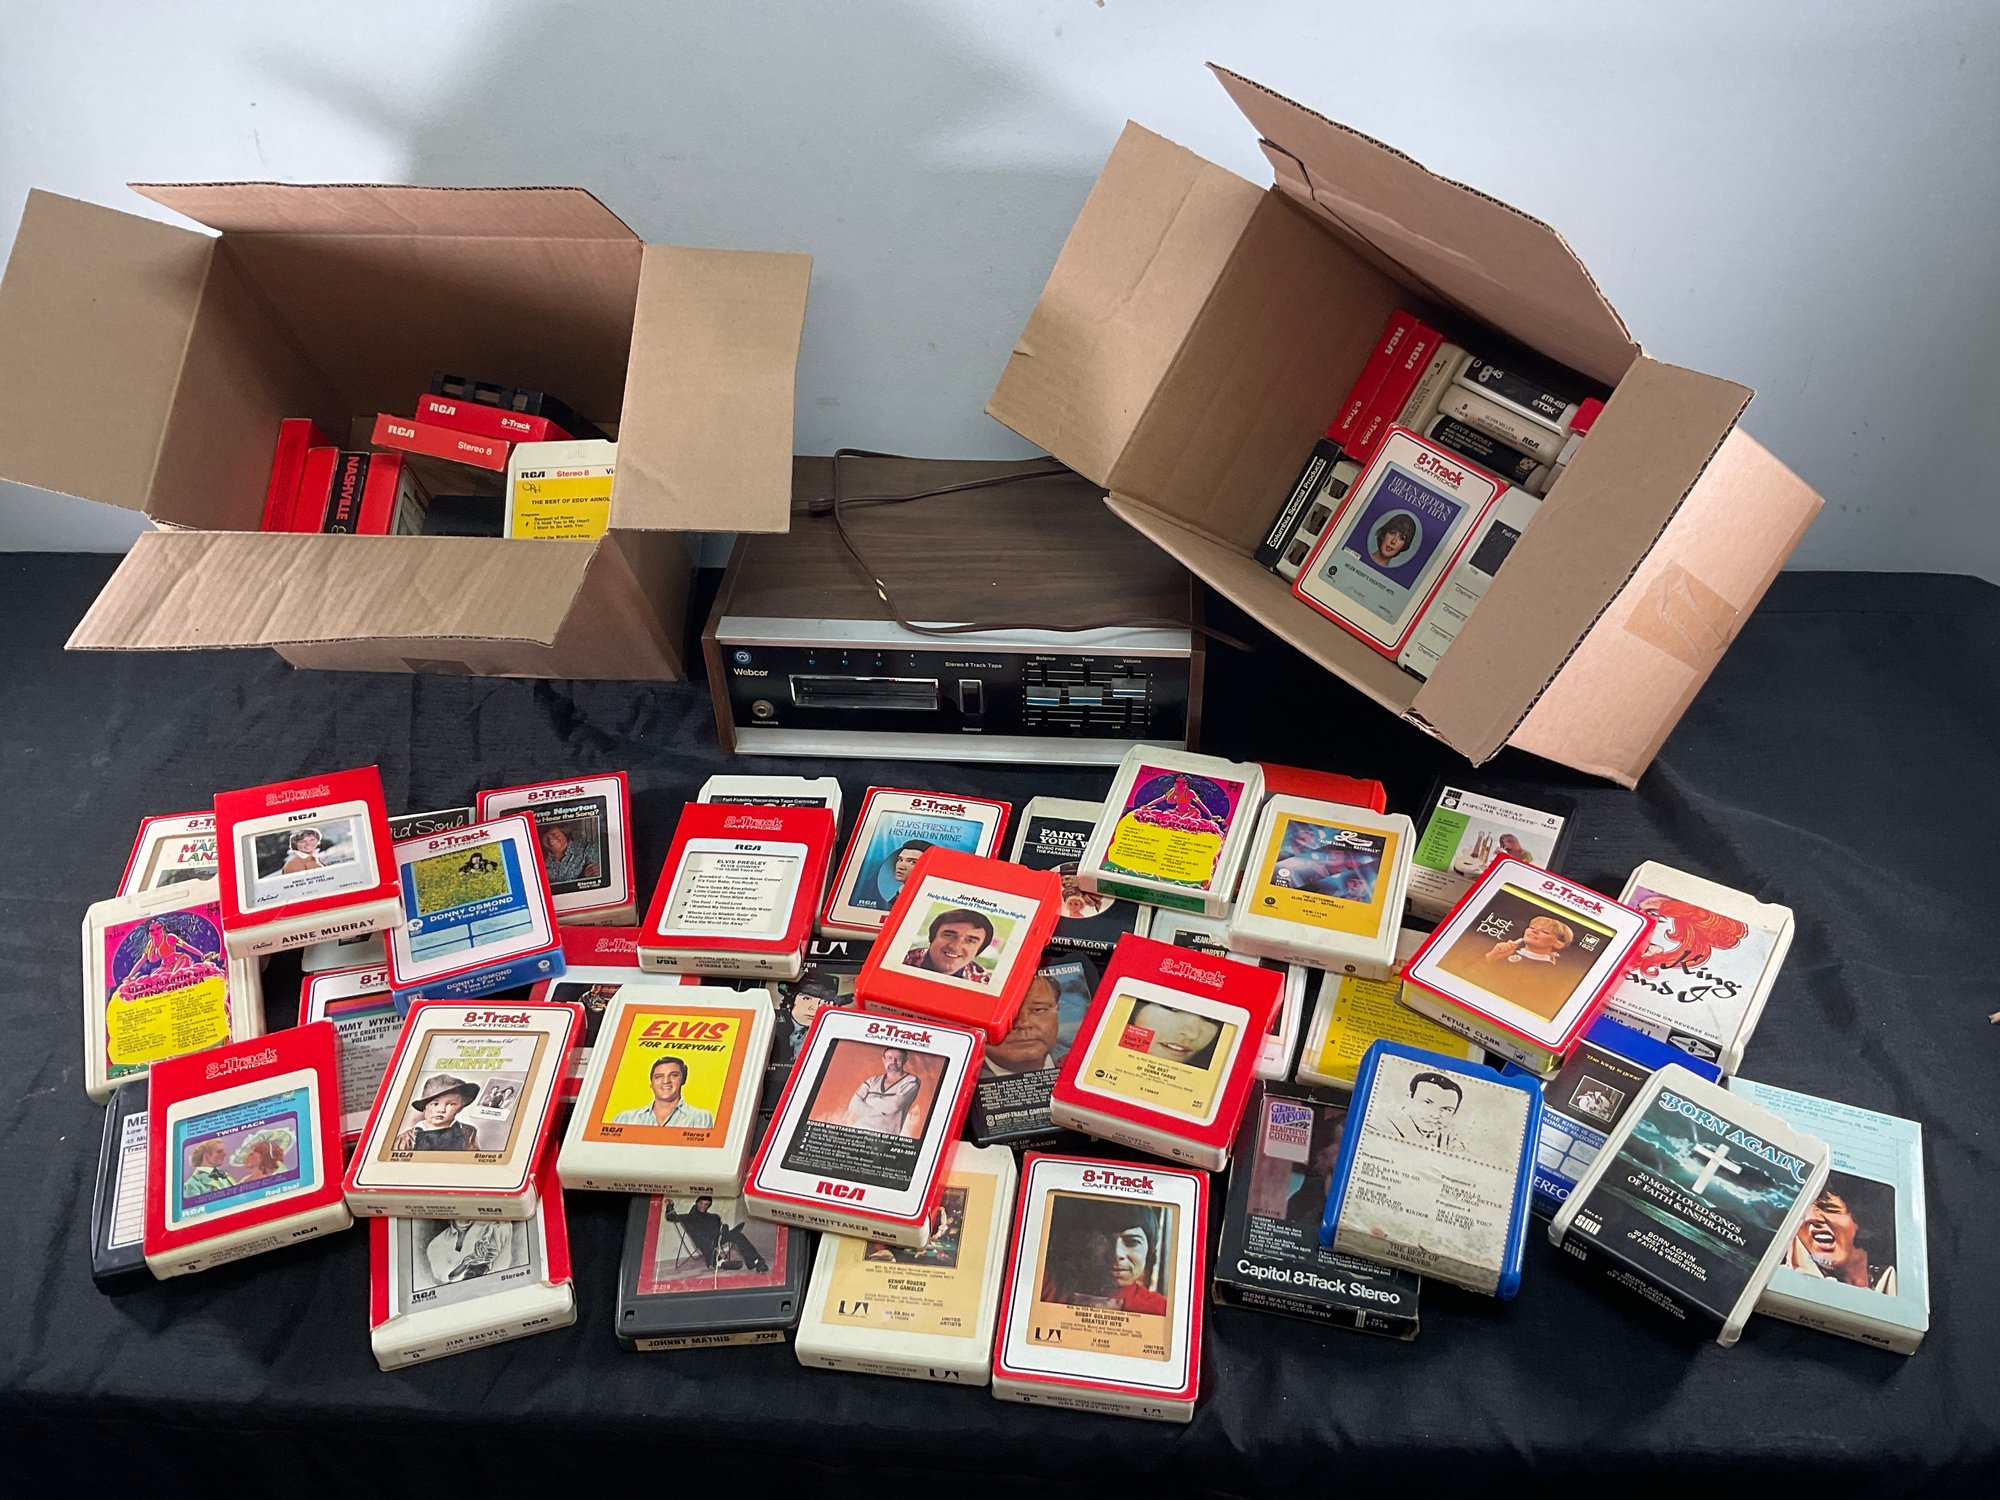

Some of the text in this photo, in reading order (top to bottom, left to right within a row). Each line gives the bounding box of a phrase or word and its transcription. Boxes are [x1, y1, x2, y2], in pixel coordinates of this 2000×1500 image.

[1385, 327, 1405, 355] RCA
[1405, 342, 1425, 369] RCA
[430, 402, 456, 416] RCA
[1538, 401, 1556, 415] TDK
[388, 424, 415, 438] RCA
[1449, 422, 1468, 435] LOVE
[1468, 432, 1494, 447] STORY
[458, 441, 492, 456] Stereo 8
[1522, 436, 1540, 449] RCA
[1416, 453, 1464, 486] 8-Track
[336, 456, 361, 521] NASHVILLE
[1393, 476, 1421, 496] HELEN
[1270, 459, 1324, 547] Columbia Special Products
[733, 667, 769, 679] Webcor
[528, 786, 585, 800] 8-Track
[911, 798, 966, 814] 8-Track
[1462, 802, 1494, 814] POPULAR
[288, 812, 317, 822] RCA
[416, 817, 465, 834] Soul
[428, 829, 490, 850] 8-Track
[889, 827, 962, 843] HIS HAND IN MINE
[1040, 828, 1085, 840] PAINT
[1040, 836, 1076, 847] YOUR
[957, 893, 998, 908] Jim Nabors
[1542, 880, 1605, 914] 8-Track
[430, 896, 514, 923] DONNY OSMOND
[456, 912, 475, 921] Time
[477, 909, 487, 918] For
[488, 906, 498, 915] Us
[927, 892, 942, 900] Help
[942, 894, 952, 902] Me
[952, 896, 968, 906] Make
[973, 902, 999, 914] Through
[998, 907, 1010, 916] The
[1009, 909, 1026, 920] Night
[1475, 921, 1506, 940] pet
[1481, 912, 1513, 933] just
[282, 919, 375, 944] ANNE MURRAY
[1038, 965, 1081, 977] GLEASON
[1160, 957, 1226, 984] 8-Track
[1660, 949, 1744, 1000] King
[128, 968, 210, 994] DEAN MARTIN and
[446, 968, 512, 991] DONNY OSMOND
[133, 978, 206, 1000] FRANK SINATRA
[463, 1011, 532, 1024] 8-Track
[641, 1020, 730, 1040] ELVIS
[867, 1022, 933, 1044] 8-Track
[1441, 1013, 1501, 1047] PETULA CLARK
[638, 1040, 727, 1052] FOR EVERYONE!
[864, 1033, 930, 1049] CARTRIDGE
[205, 1048, 278, 1075] 8-Track
[1271, 1103, 1296, 1113] GENE
[215, 1120, 266, 1138] TWIN PACK
[1269, 1124, 1309, 1137] BEAUTIFUL
[1268, 1132, 1308, 1146] COUNTRY
[1660, 1091, 1727, 1136] BORN
[1728, 1126, 1807, 1185] AGAIN
[1082, 1170, 1154, 1191] 8-Track
[1082, 1182, 1154, 1196] CARTRIDGE
[265, 1182, 300, 1197] Red Seal
[816, 1181, 866, 1201] RCA
[1627, 1175, 1747, 1247] OF FAITH & INSPIRATION
[1637, 1171, 1742, 1234] 20 MOST LOVED SONGS
[181, 1206, 206, 1218] RCA
[770, 1208, 869, 1232] ROGER WHITTAKER
[1452, 1212, 1474, 1222] LOSING
[1476, 1220, 1493, 1228] YOU?
[872, 1230, 897, 1239] RCA
[1647, 1232, 1696, 1263] BORN AGAIN
[1386, 1250, 1432, 1267] JIM REEVES
[500, 1269, 531, 1282] Stereo 8
[412, 1289, 437, 1301] RCA
[1293, 1271, 1346, 1294] 8-Track
[1349, 1282, 1400, 1304] Stereo
[522, 1317, 549, 1328] RCA
[1081, 1317, 1107, 1325] GREATEST
[1093, 1312, 1130, 1323] GOLDSBORO'S
[445, 1328, 507, 1348] JIM REEVES
[648, 1336, 730, 1347] JOHNNY MATHIS
[1862, 1333, 1890, 1345] RCA
